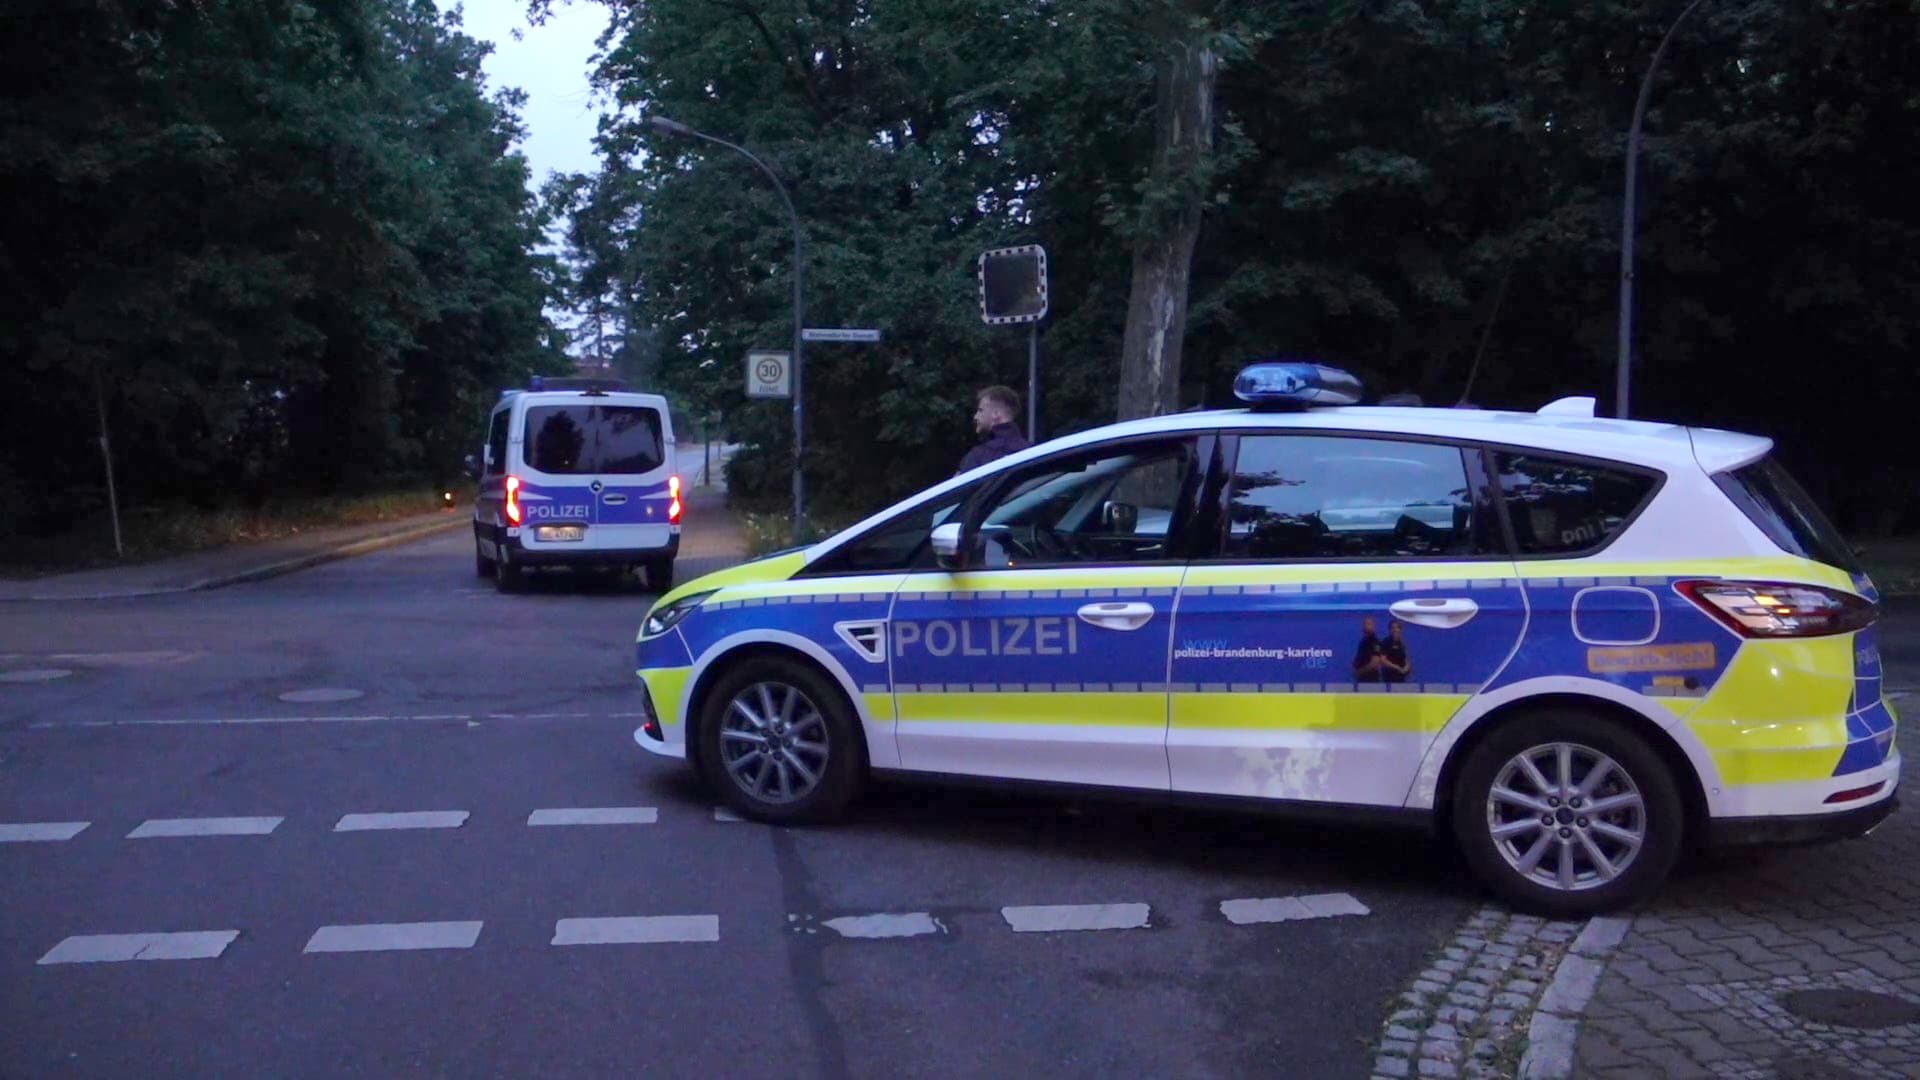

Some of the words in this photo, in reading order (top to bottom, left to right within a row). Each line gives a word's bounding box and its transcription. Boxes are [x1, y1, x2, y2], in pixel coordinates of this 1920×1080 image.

[761, 364, 777, 377] 30
[527, 505, 589, 518] POLIZEI
[895, 617, 1077, 657] POLIZEI
[1174, 647, 1333, 660] polizei-brandenburg-karriere
